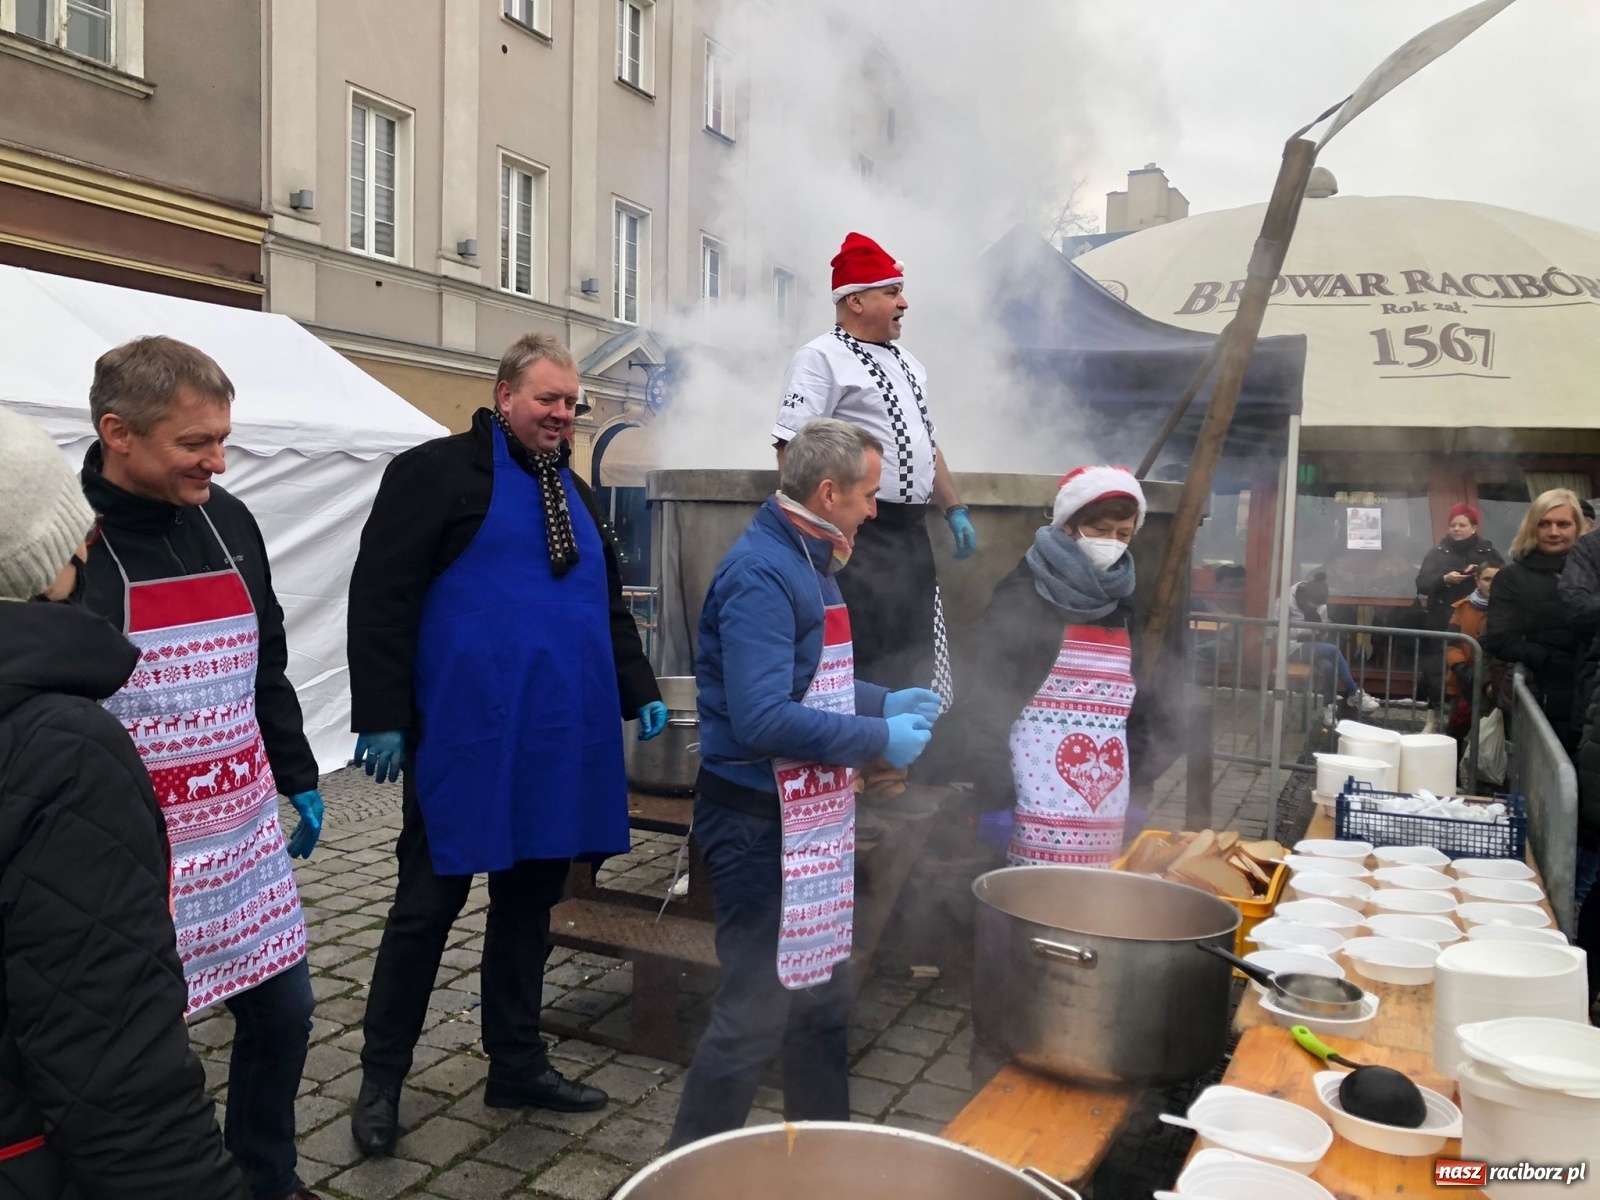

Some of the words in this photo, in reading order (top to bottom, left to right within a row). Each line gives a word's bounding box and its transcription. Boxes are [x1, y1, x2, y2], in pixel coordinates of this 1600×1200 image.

[1400, 266, 1600, 300] RACIBÓR
[1381, 301, 1430, 314] Rok
[1370, 323, 1495, 370] 1567
